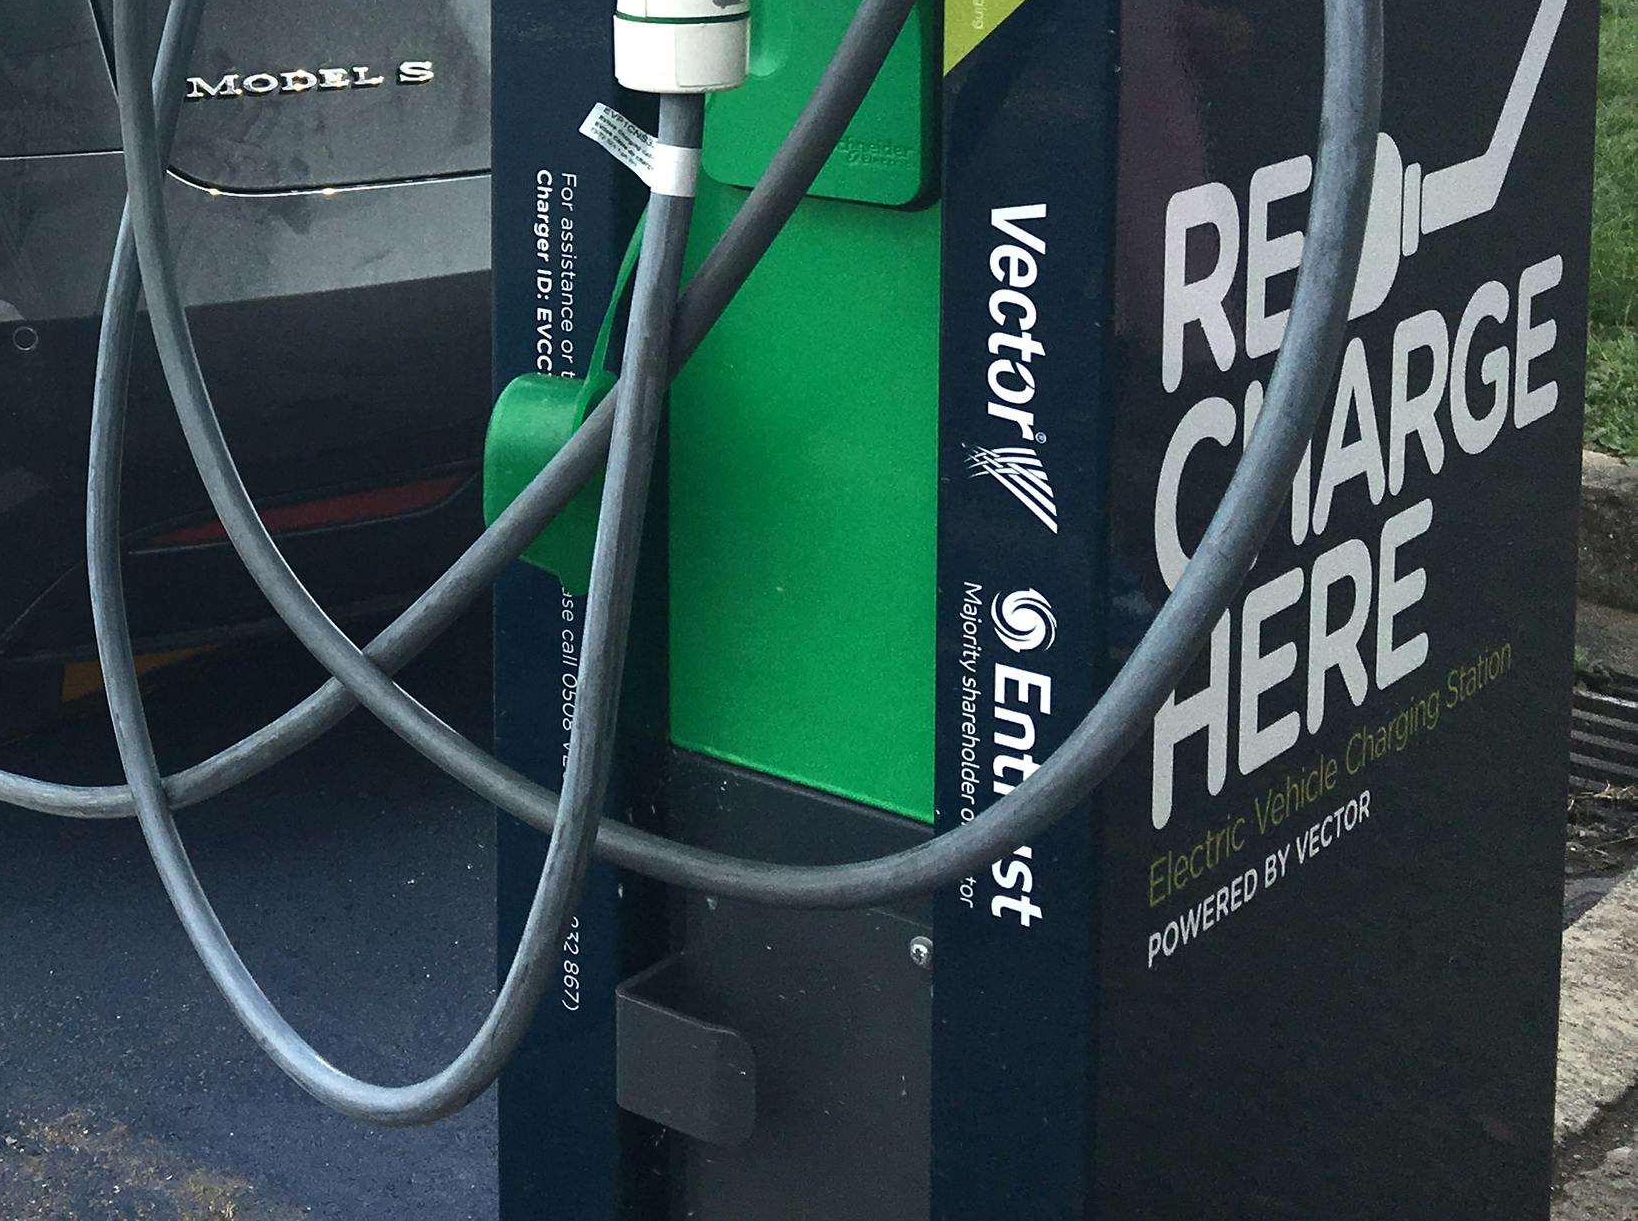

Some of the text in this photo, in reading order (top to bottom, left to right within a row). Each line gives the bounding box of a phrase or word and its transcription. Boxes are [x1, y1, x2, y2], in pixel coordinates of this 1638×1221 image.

[185, 60, 435, 99] MODEL S
[560, 171, 577, 212] For
[533, 169, 553, 376] Charger ID: EVCC
[560, 217, 578, 333] assistance
[987, 203, 1047, 442] Vector
[1163, 154, 1313, 394] RE
[560, 337, 576, 363] or
[562, 629, 579, 667] call
[959, 580, 983, 668] Majority
[1151, 498, 1433, 831] HERE
[960, 677, 982, 805] shareholder
[1149, 642, 1512, 908] Electric Vehicle Charging Station
[1147, 789, 1372, 969] POWERED BY VECTOR
[561, 960, 580, 1011] 867)
